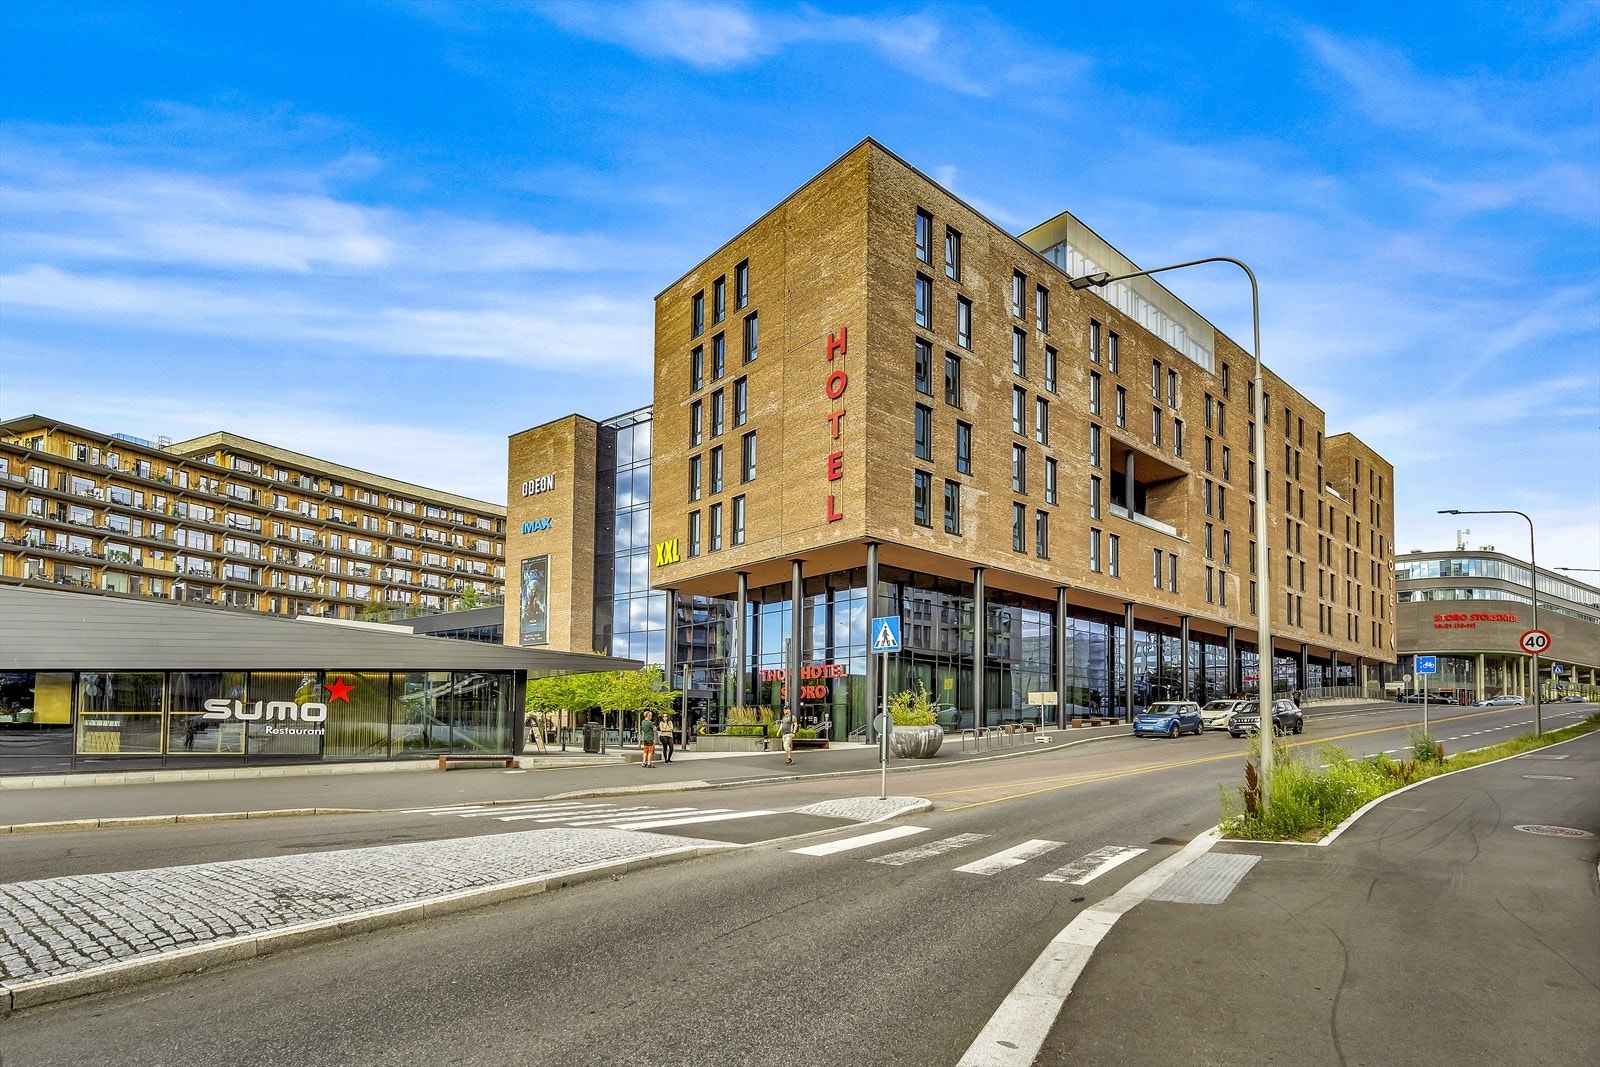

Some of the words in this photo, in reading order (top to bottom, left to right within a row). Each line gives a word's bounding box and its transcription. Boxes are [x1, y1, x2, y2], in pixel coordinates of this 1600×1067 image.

[826, 327, 847, 522] HOTEL
[522, 475, 555, 497] ODEON
[522, 518, 551, 534] IMAX
[656, 539, 680, 567] XXL
[1525, 635, 1546, 648] 40
[760, 669, 792, 682] THO
[800, 664, 848, 680] HOTEL
[781, 685, 827, 699] SORO
[265, 725, 326, 736] Restaurant
